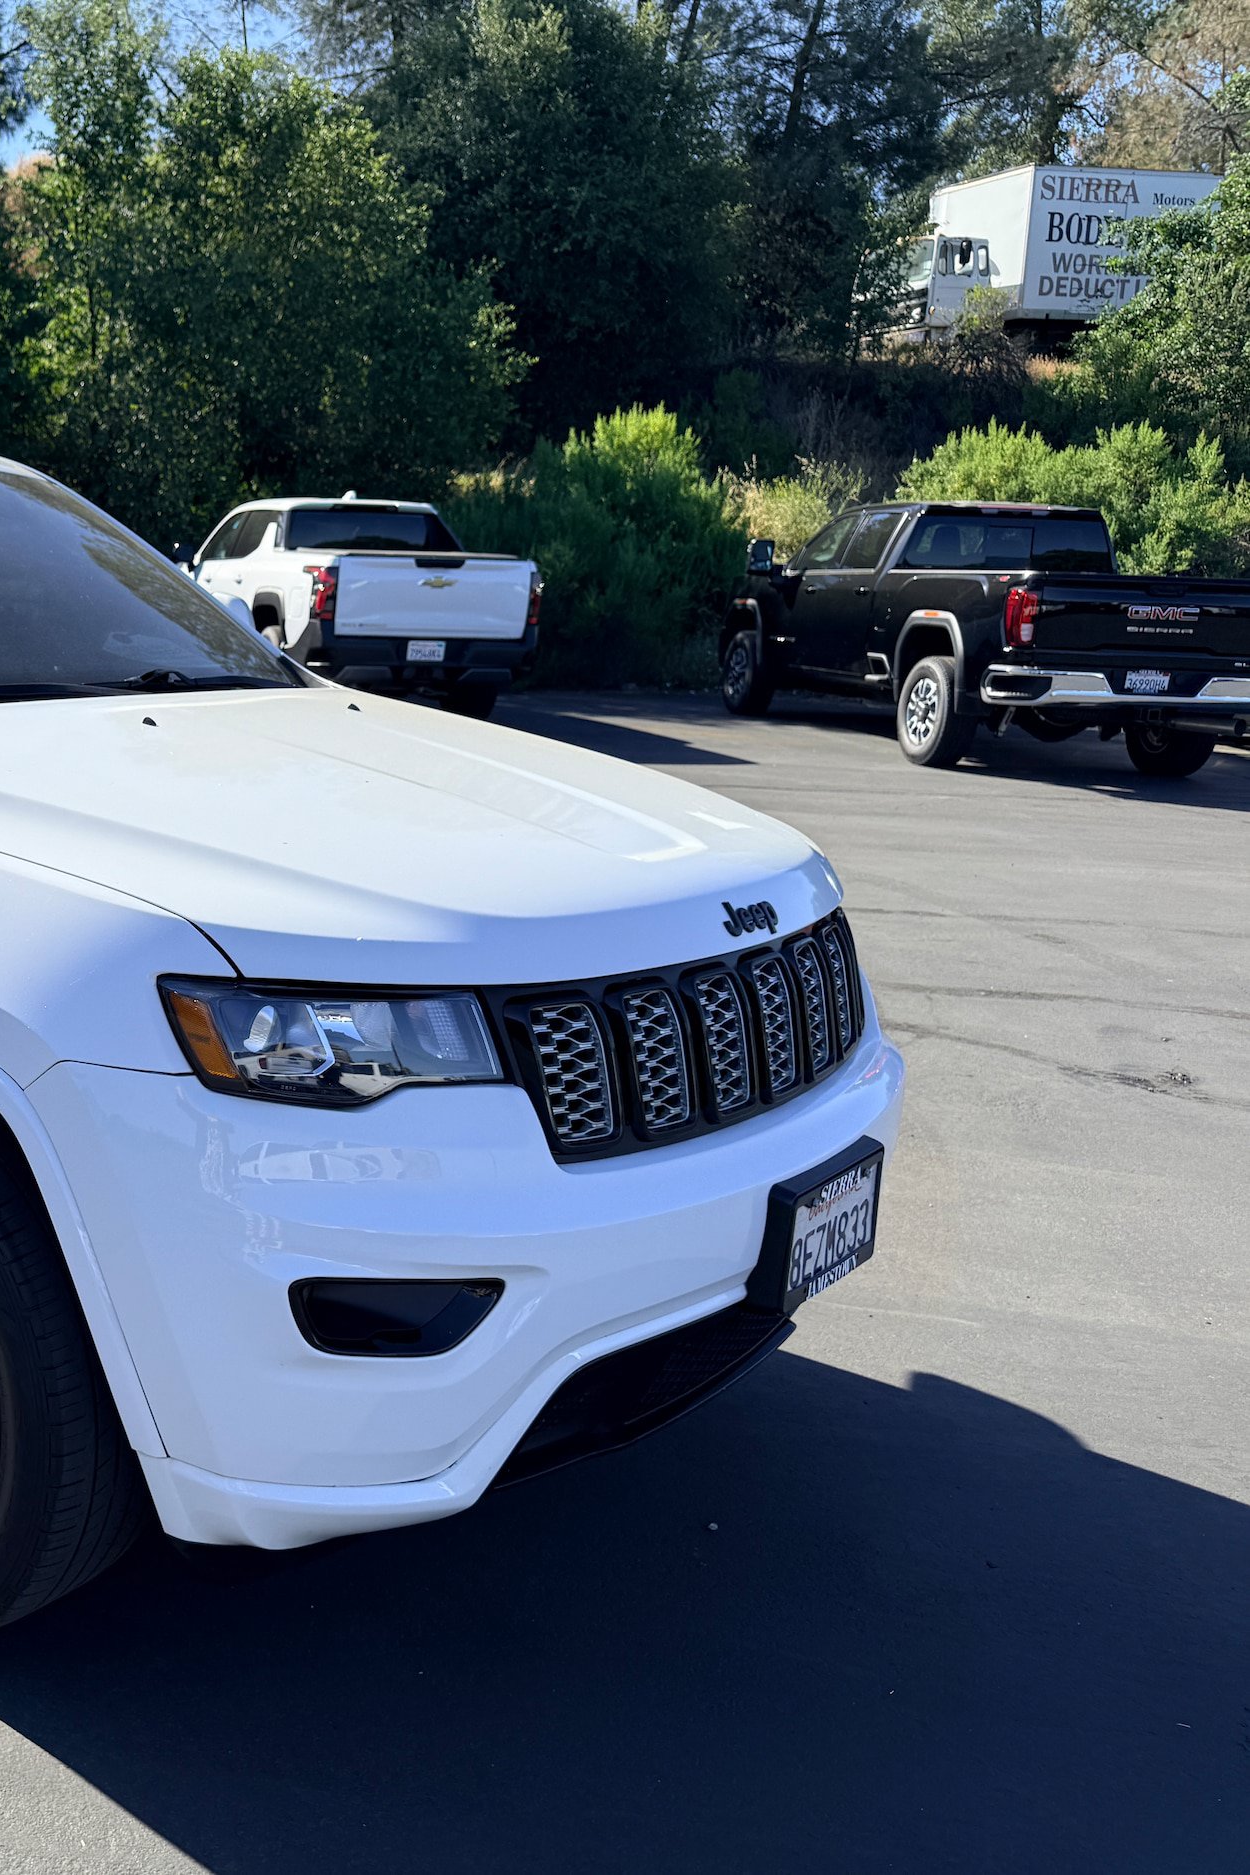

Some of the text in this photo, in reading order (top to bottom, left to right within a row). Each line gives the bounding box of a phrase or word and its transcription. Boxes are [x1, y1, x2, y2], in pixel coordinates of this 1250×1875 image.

[1040, 174, 1196, 206] SIERRA Motors
[1052, 252, 1116, 275] WOR
[1127, 605, 1200, 621] GMC
[721, 900, 778, 937] Jeep
[821, 1166, 862, 1204] SIERRA
[789, 1198, 870, 1290] 8EZM833
[806, 1253, 859, 1300] JAMESTOWN
